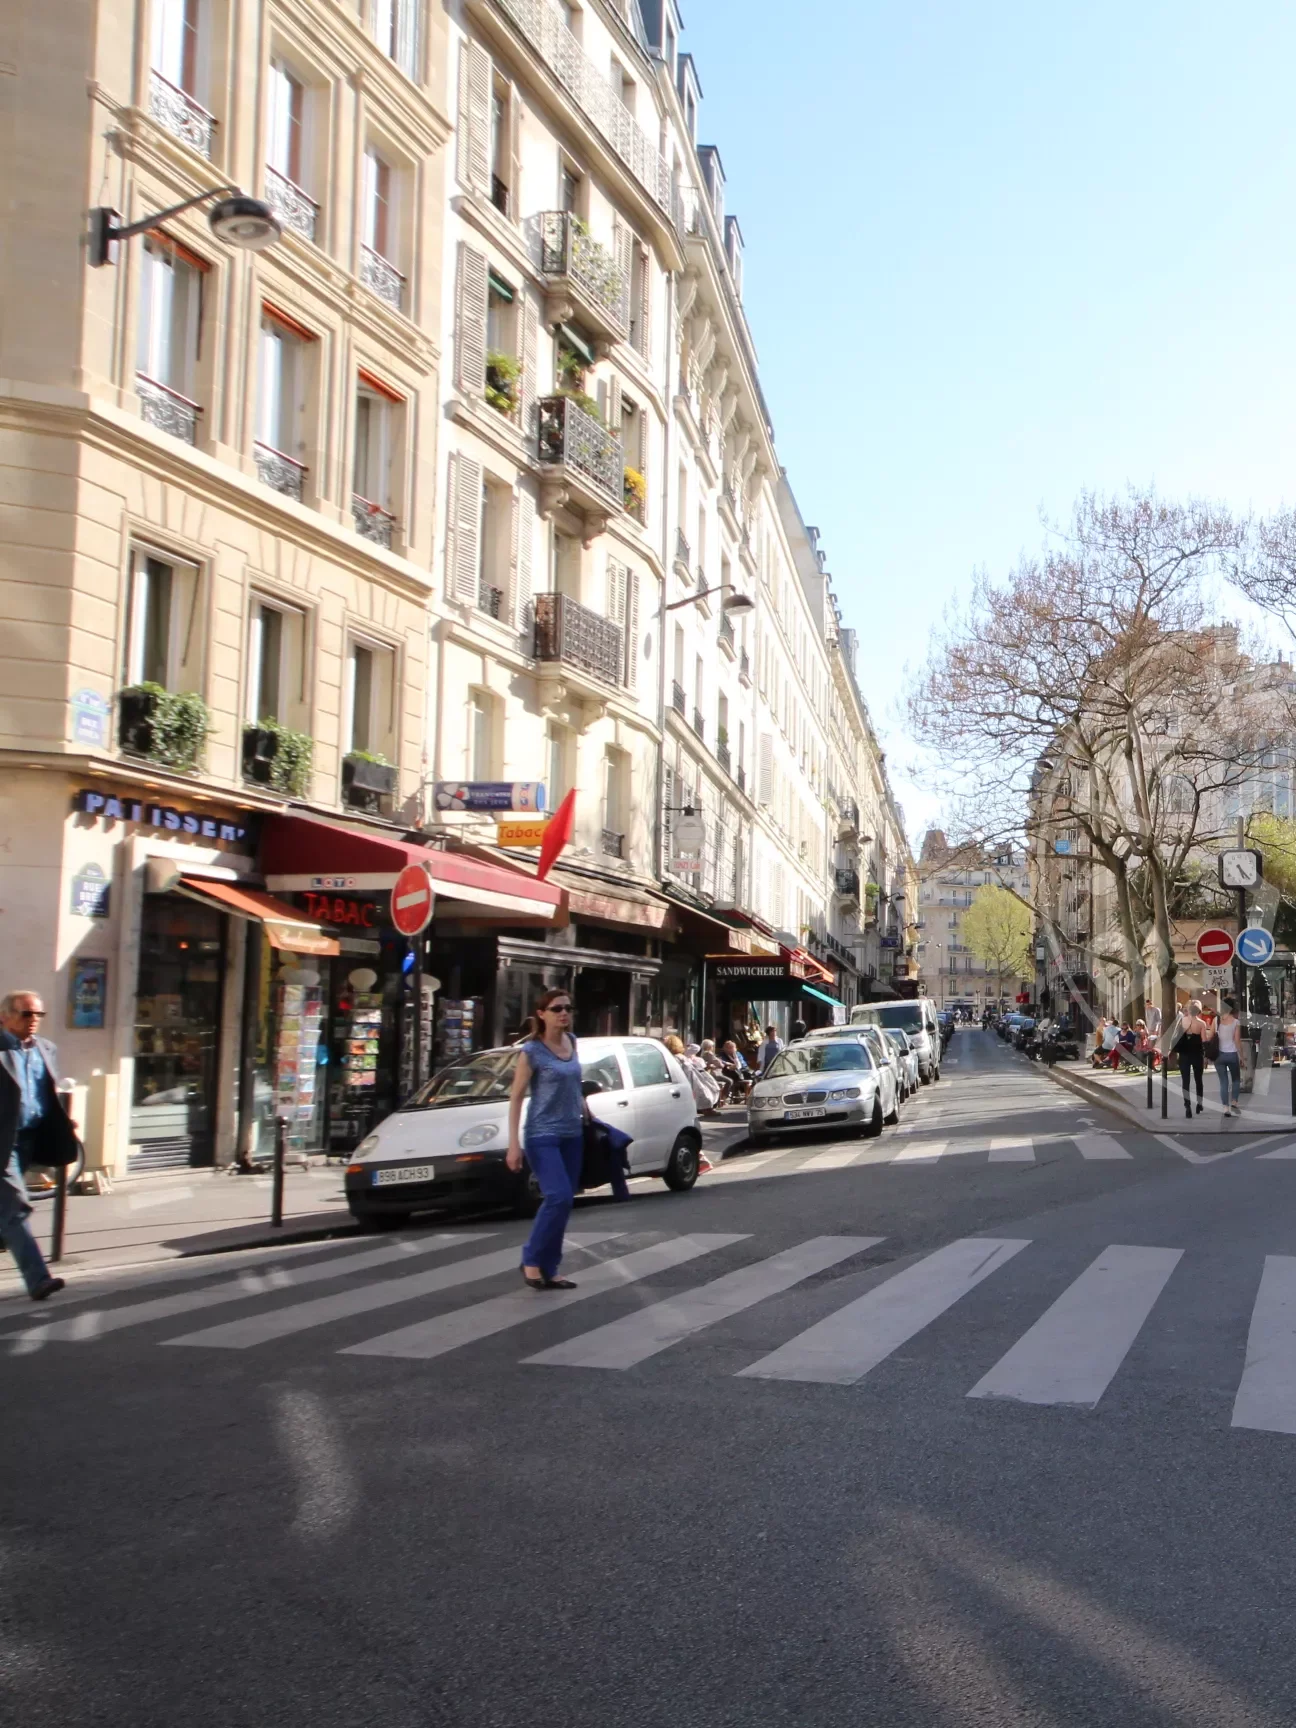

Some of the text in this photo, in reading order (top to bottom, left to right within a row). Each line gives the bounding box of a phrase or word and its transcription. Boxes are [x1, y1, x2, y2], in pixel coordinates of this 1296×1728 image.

[499, 826, 541, 838] Tabac
[312, 877, 356, 888] LOTO
[303, 892, 374, 928] TABAC
[716, 966, 784, 976] SANDWICHERIE
